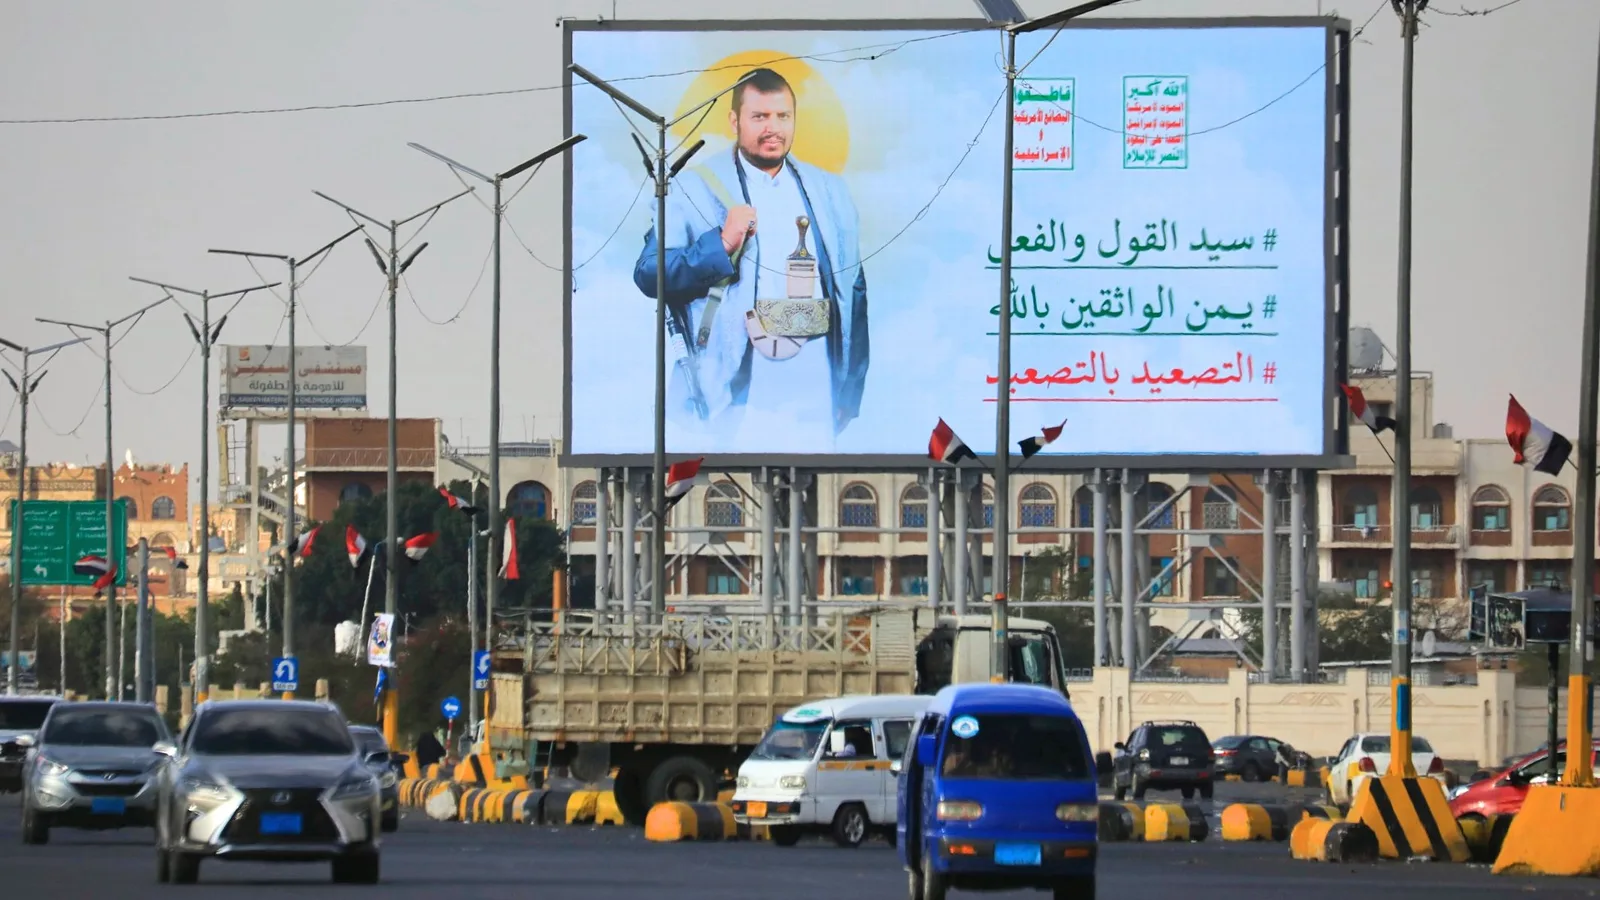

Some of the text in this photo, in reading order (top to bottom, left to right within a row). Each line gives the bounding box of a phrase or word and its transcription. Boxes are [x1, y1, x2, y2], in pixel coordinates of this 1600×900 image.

[1097, 218, 1177, 266] القول
[1189, 228, 1254, 261] سيد
[1061, 284, 1175, 333] الواثقين
[1185, 300, 1253, 332] يمن
[249, 380, 301, 393] ولطفولة
[1131, 351, 1253, 394] التصعيد
